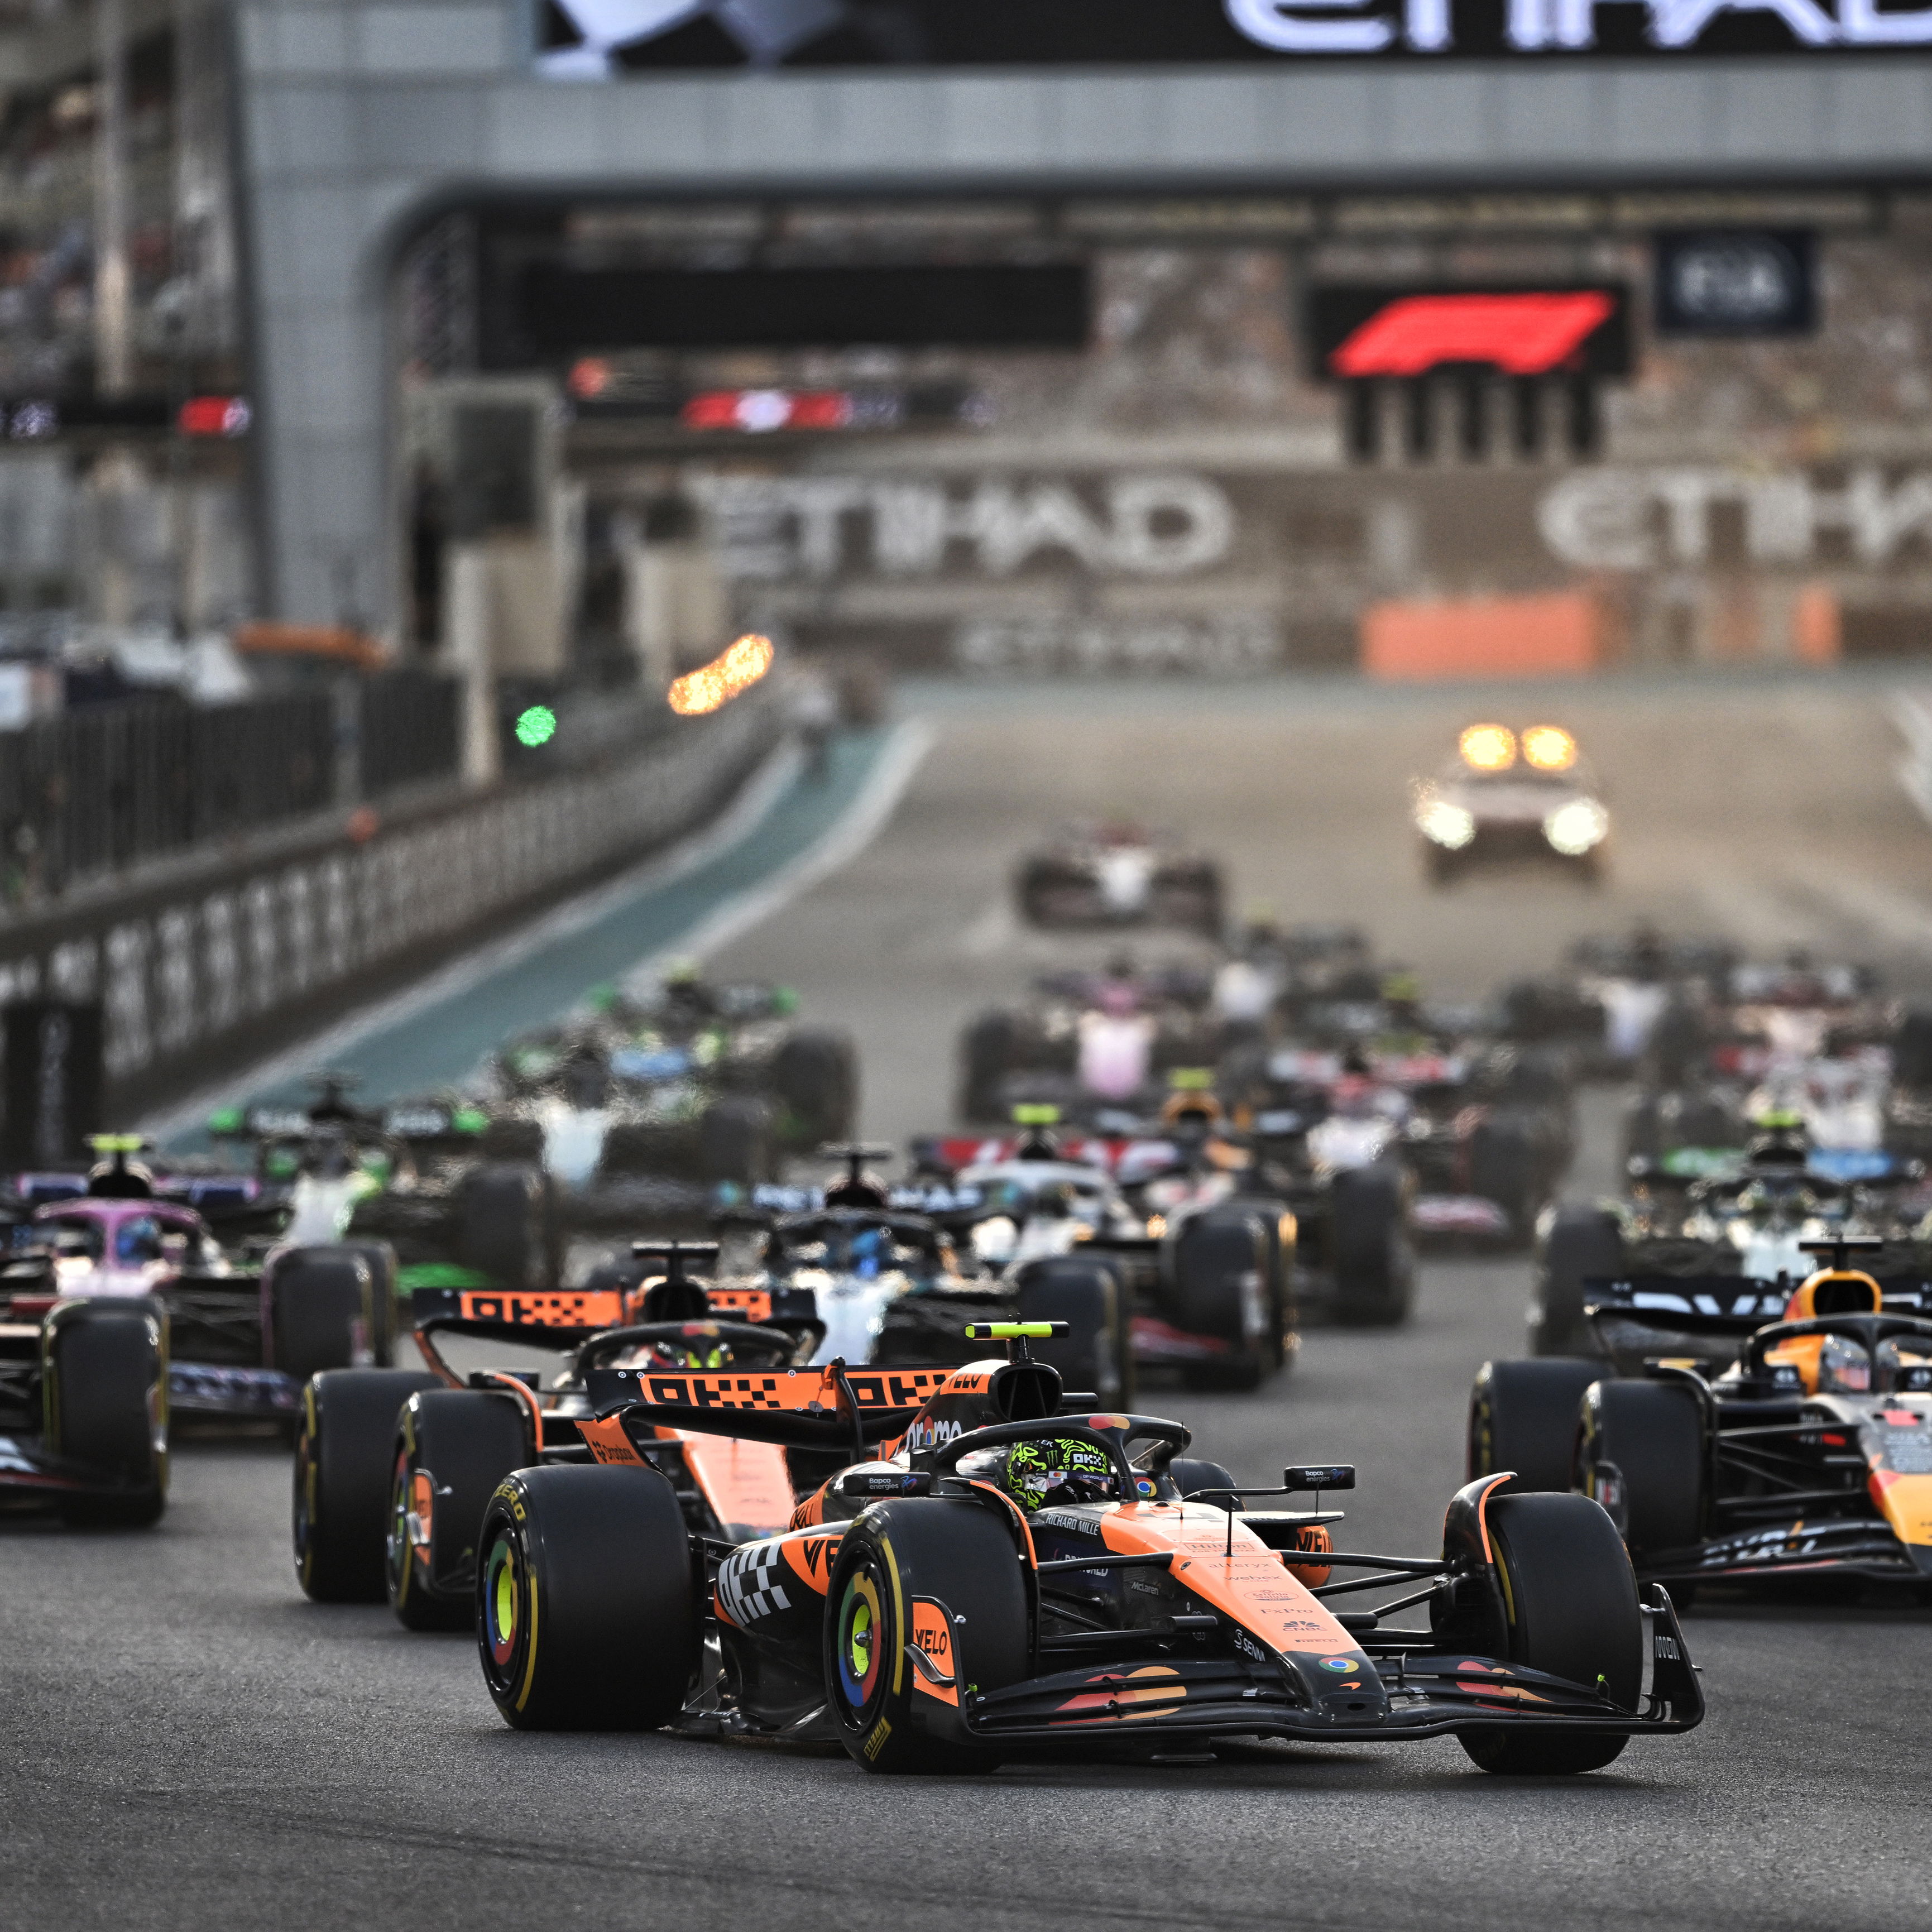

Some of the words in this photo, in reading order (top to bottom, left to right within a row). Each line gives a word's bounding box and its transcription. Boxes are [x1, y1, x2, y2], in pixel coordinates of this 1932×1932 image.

[649, 1378, 781, 1409] OKX
[1073, 1454, 1101, 1466] OKX
[494, 1484, 526, 1521] ZERO
[1046, 1513, 1077, 1530] RICHARD
[1078, 1521, 1100, 1536] MILLE
[804, 1540, 842, 1578] VE
[1131, 1581, 1159, 1595] McLaren
[915, 1629, 947, 1655] VELO
